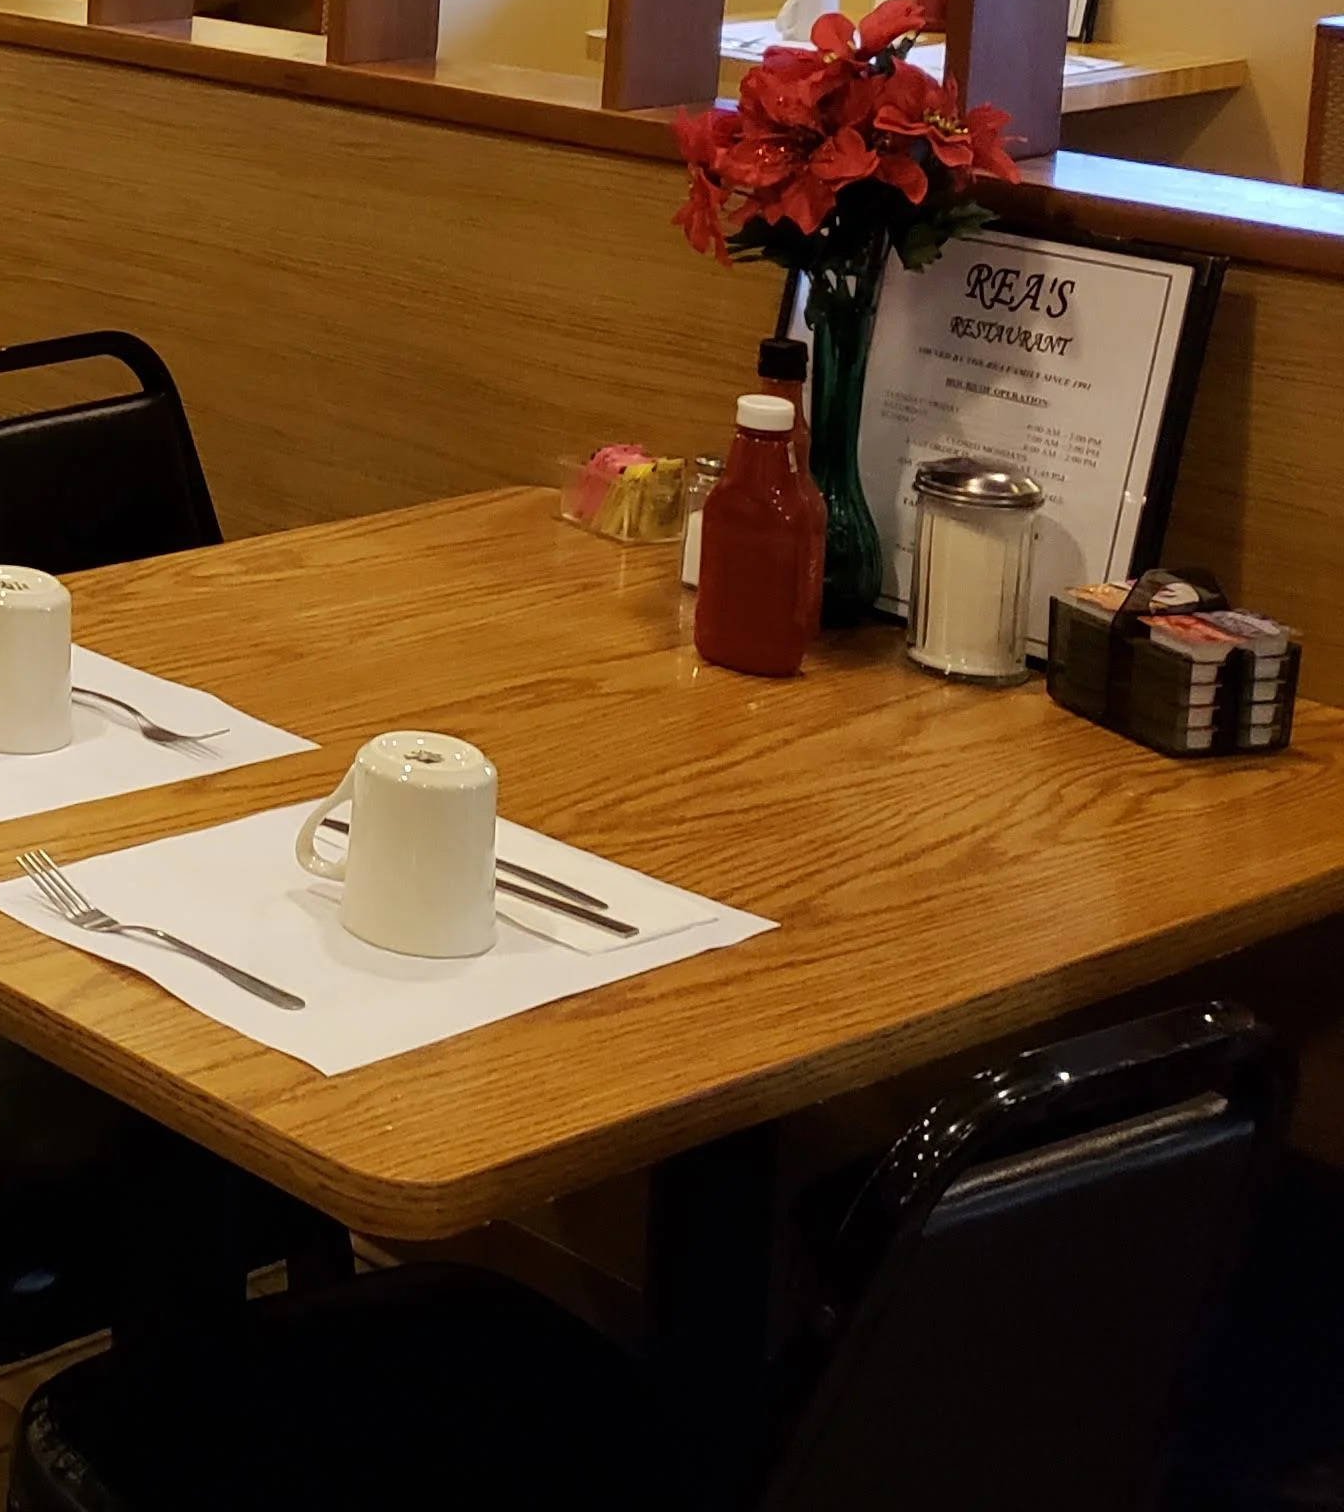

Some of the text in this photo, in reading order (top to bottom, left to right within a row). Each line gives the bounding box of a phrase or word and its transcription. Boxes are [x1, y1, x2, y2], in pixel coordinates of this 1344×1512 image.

[964, 263, 1076, 319] REA'S
[949, 315, 1074, 357] RESTAURANT
[1043, 373, 1071, 388] SINCE
[993, 387, 1050, 408] OPERATION
